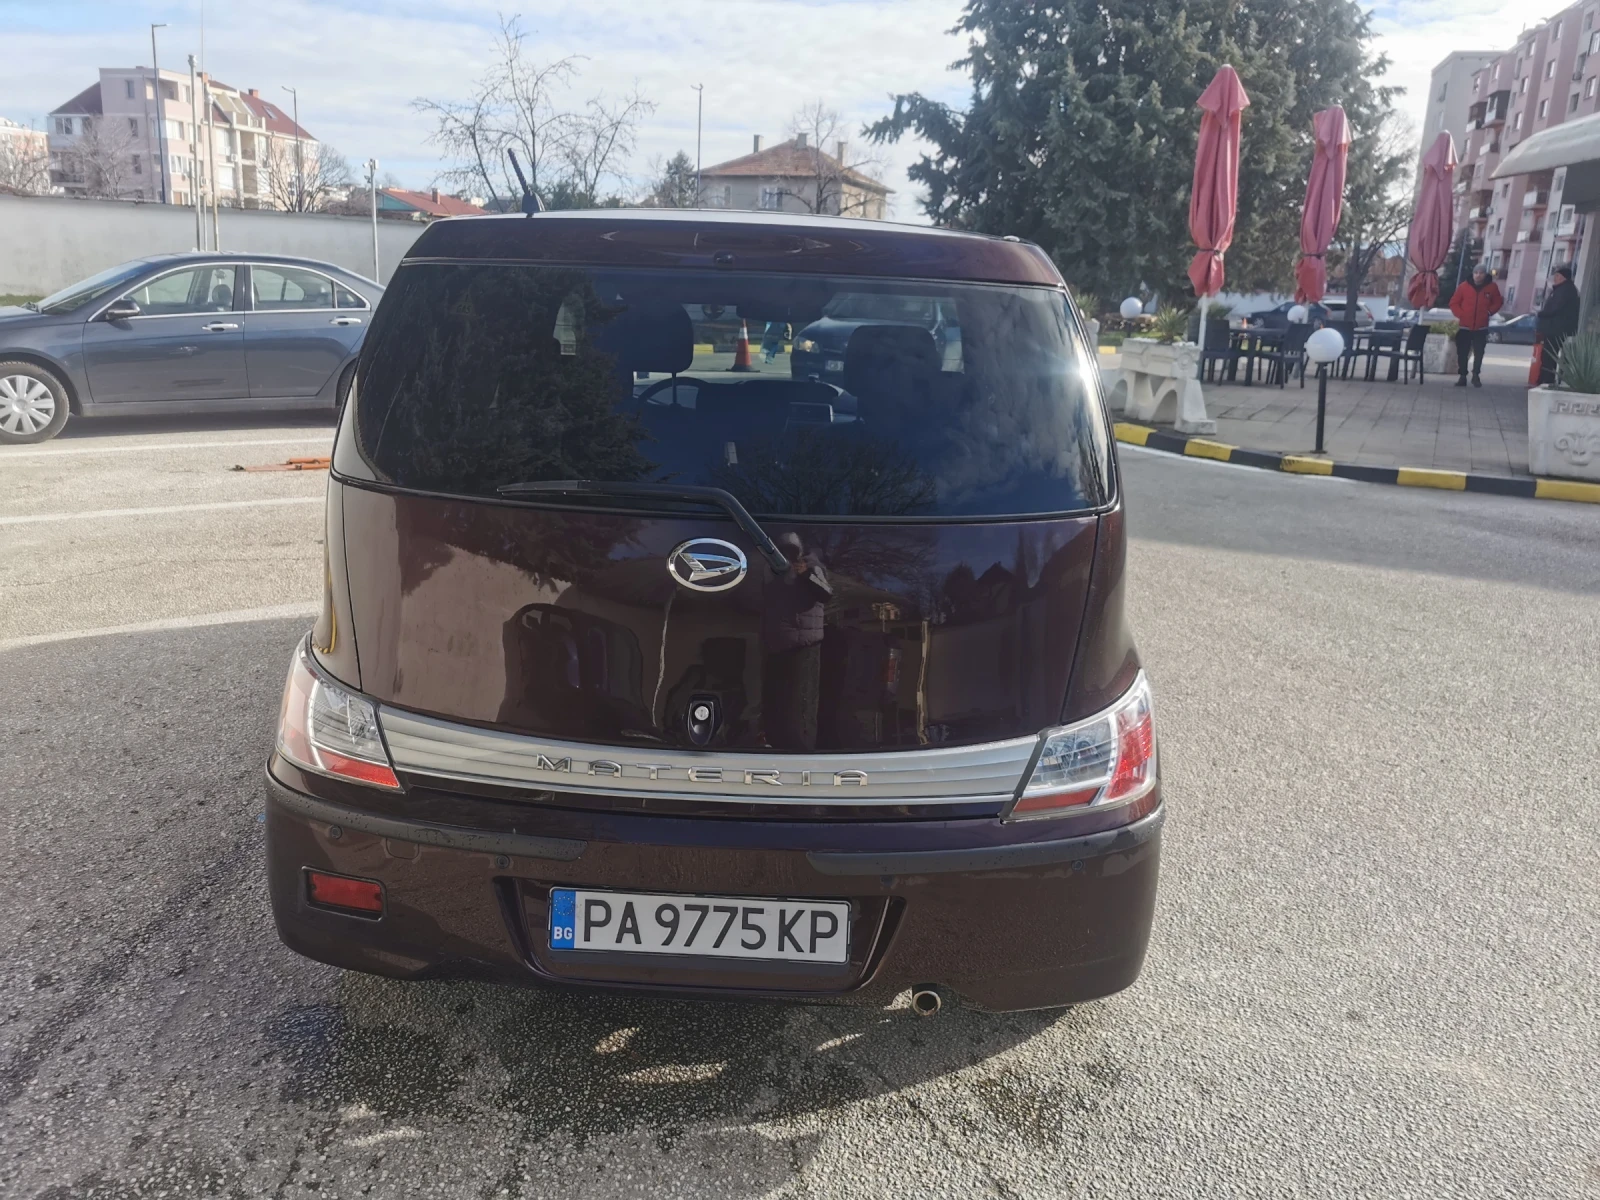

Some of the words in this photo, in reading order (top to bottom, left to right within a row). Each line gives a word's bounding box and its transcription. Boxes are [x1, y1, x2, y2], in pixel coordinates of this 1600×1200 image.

[536, 753, 868, 787] MATERIA
[553, 926, 573, 940] BG
[654, 903, 767, 950] 9775
